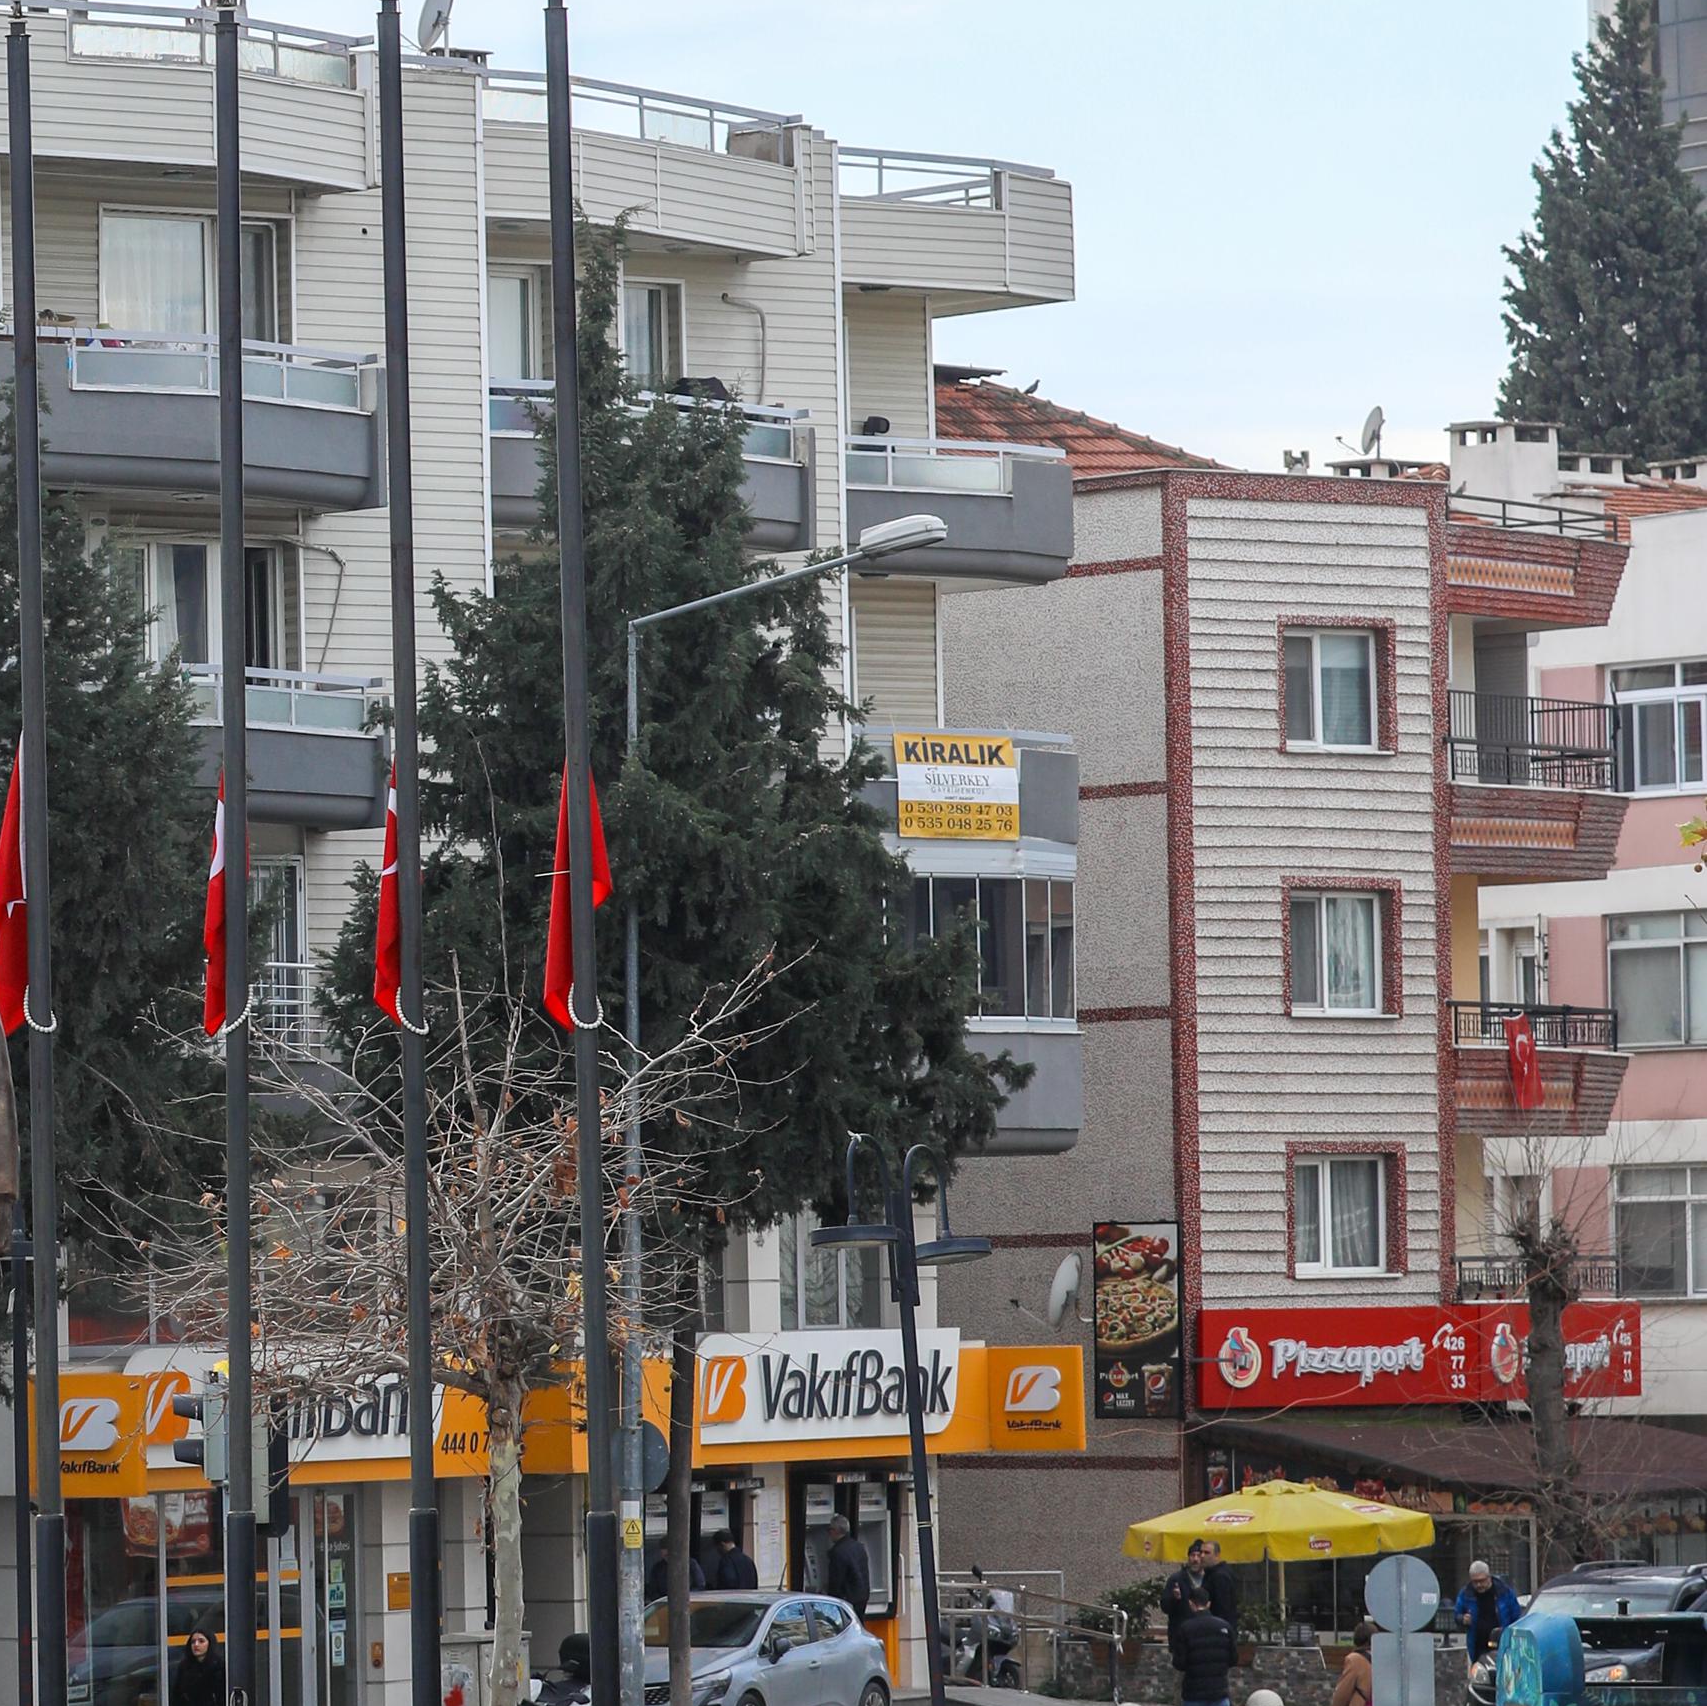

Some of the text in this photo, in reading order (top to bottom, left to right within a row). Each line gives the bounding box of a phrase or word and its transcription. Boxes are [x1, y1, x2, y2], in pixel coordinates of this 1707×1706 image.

[904, 737, 1006, 765] KİRALIK
[905, 803, 1013, 816] 0 530 289 47 03
[904, 817, 1013, 831] 0 535 048 25 76
[1443, 1336, 1466, 1351] 426
[1268, 1336, 1426, 1388] Pizzaport
[1450, 1355, 1466, 1370] 77
[1451, 1374, 1466, 1389] 33
[441, 1432, 466, 1455] 444
[470, 1431, 479, 1454] 0
